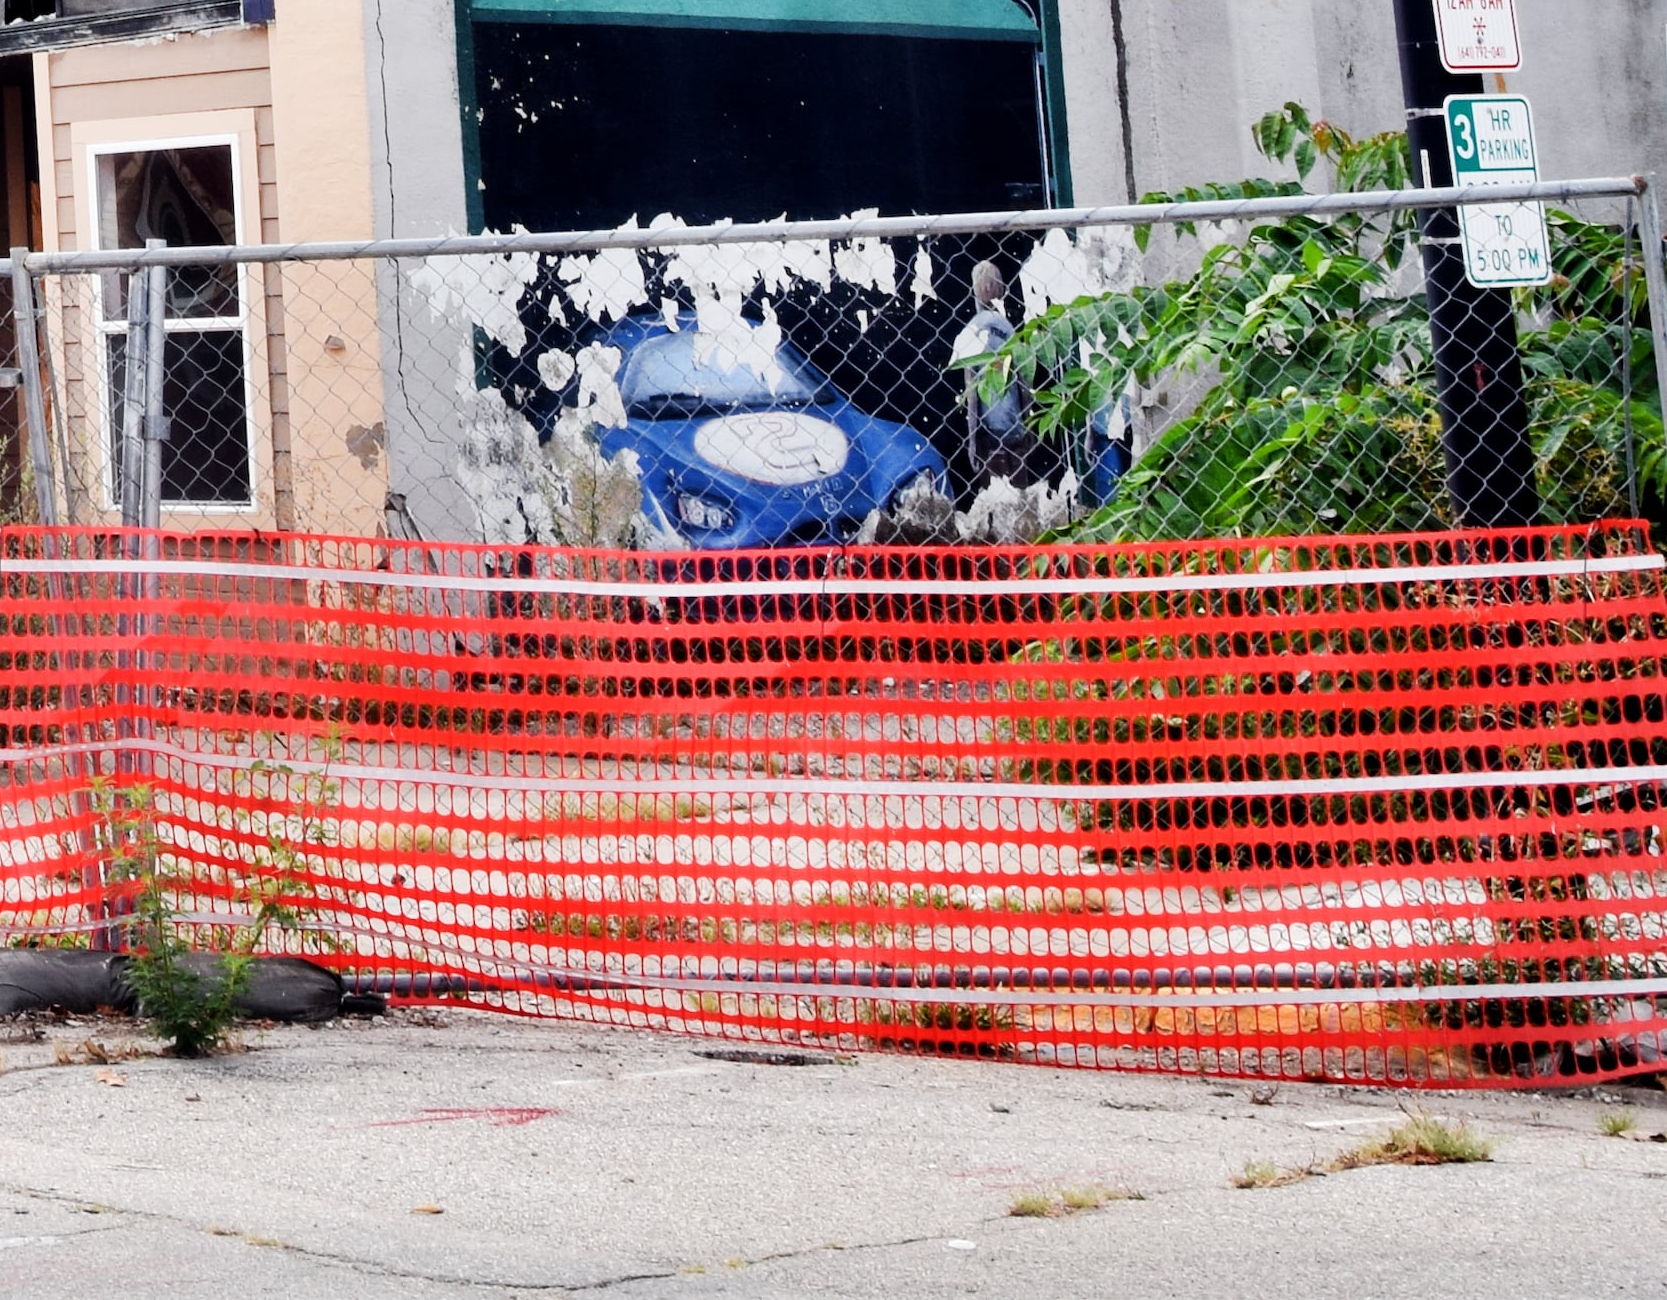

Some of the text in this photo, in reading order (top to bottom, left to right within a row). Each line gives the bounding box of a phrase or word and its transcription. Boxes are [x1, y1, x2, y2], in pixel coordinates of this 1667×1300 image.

[1490, 110, 1512, 131] HR
[1454, 114, 1474, 160] 3
[1480, 140, 1529, 160] PARKING
[1495, 215, 1513, 236] TO
[1477, 249, 1540, 272] 5:00 PM
